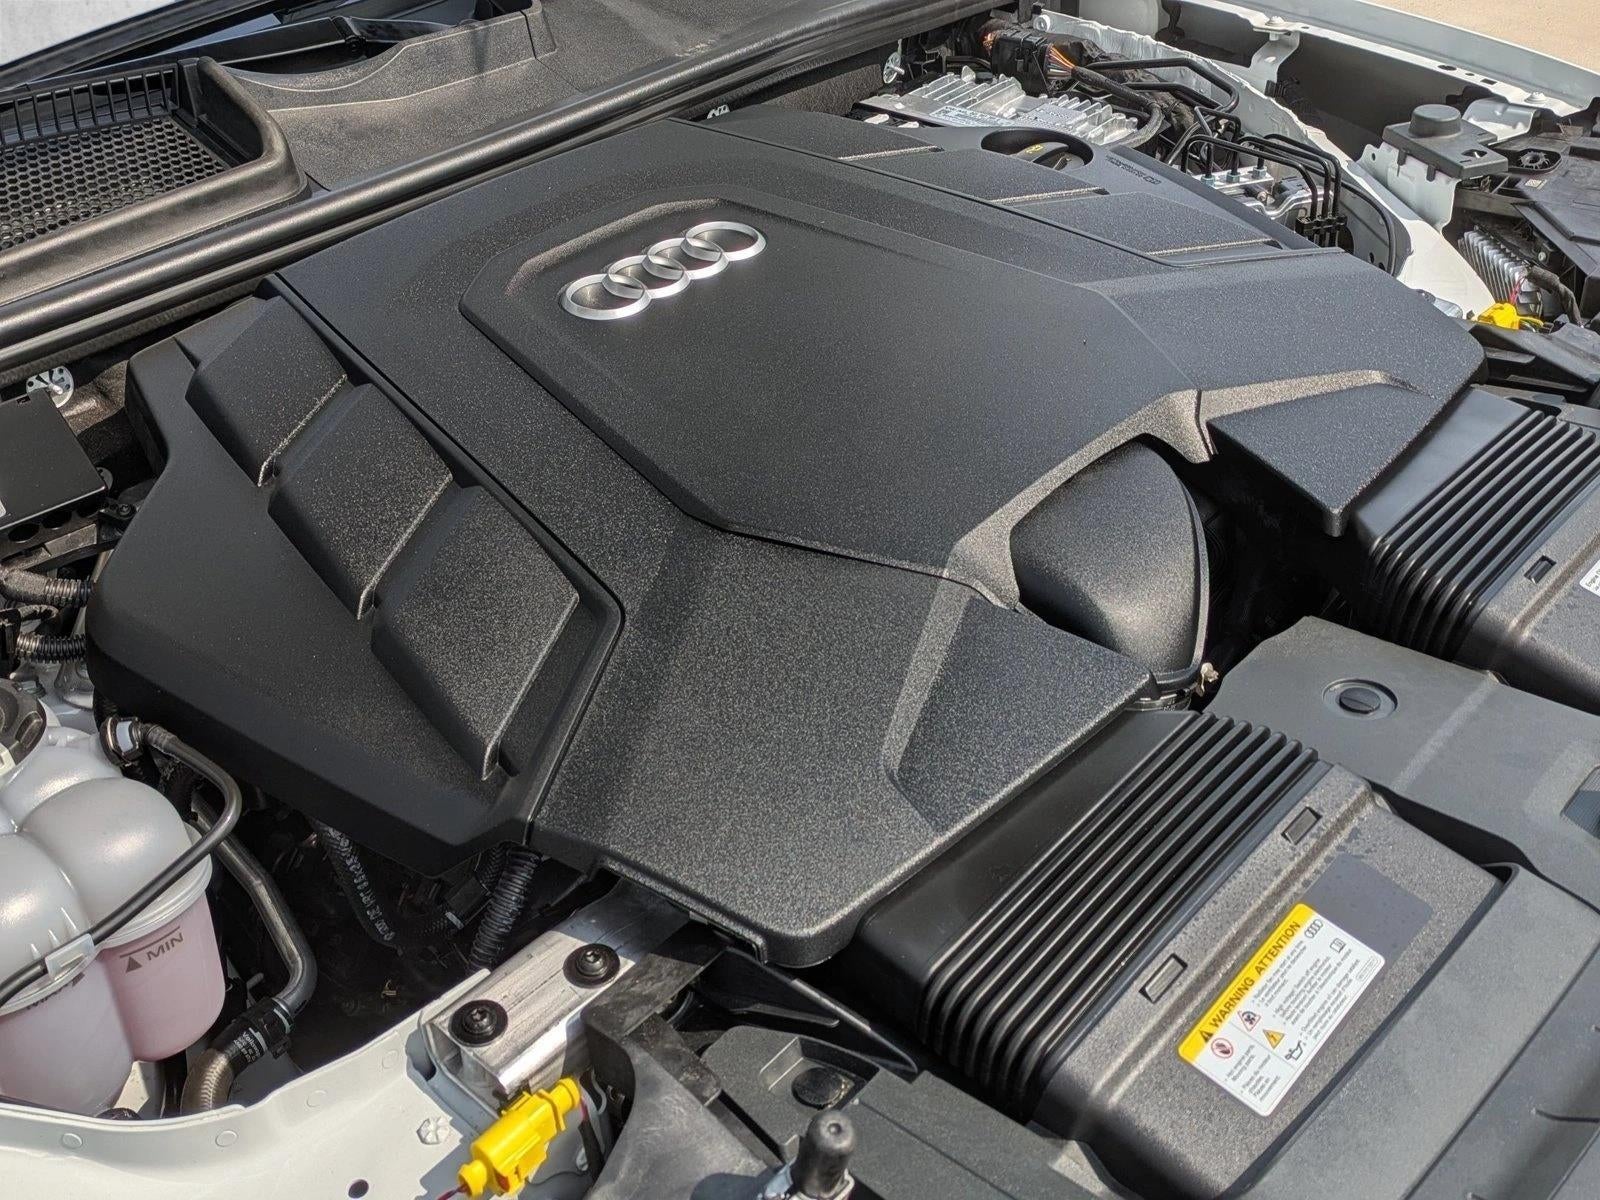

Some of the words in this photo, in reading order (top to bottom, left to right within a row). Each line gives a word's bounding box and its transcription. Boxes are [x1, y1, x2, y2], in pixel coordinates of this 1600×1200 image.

[146, 932, 184, 962] MIN
[1208, 975, 1255, 1029] WARNING
[1252, 920, 1301, 975] ATTENTION
